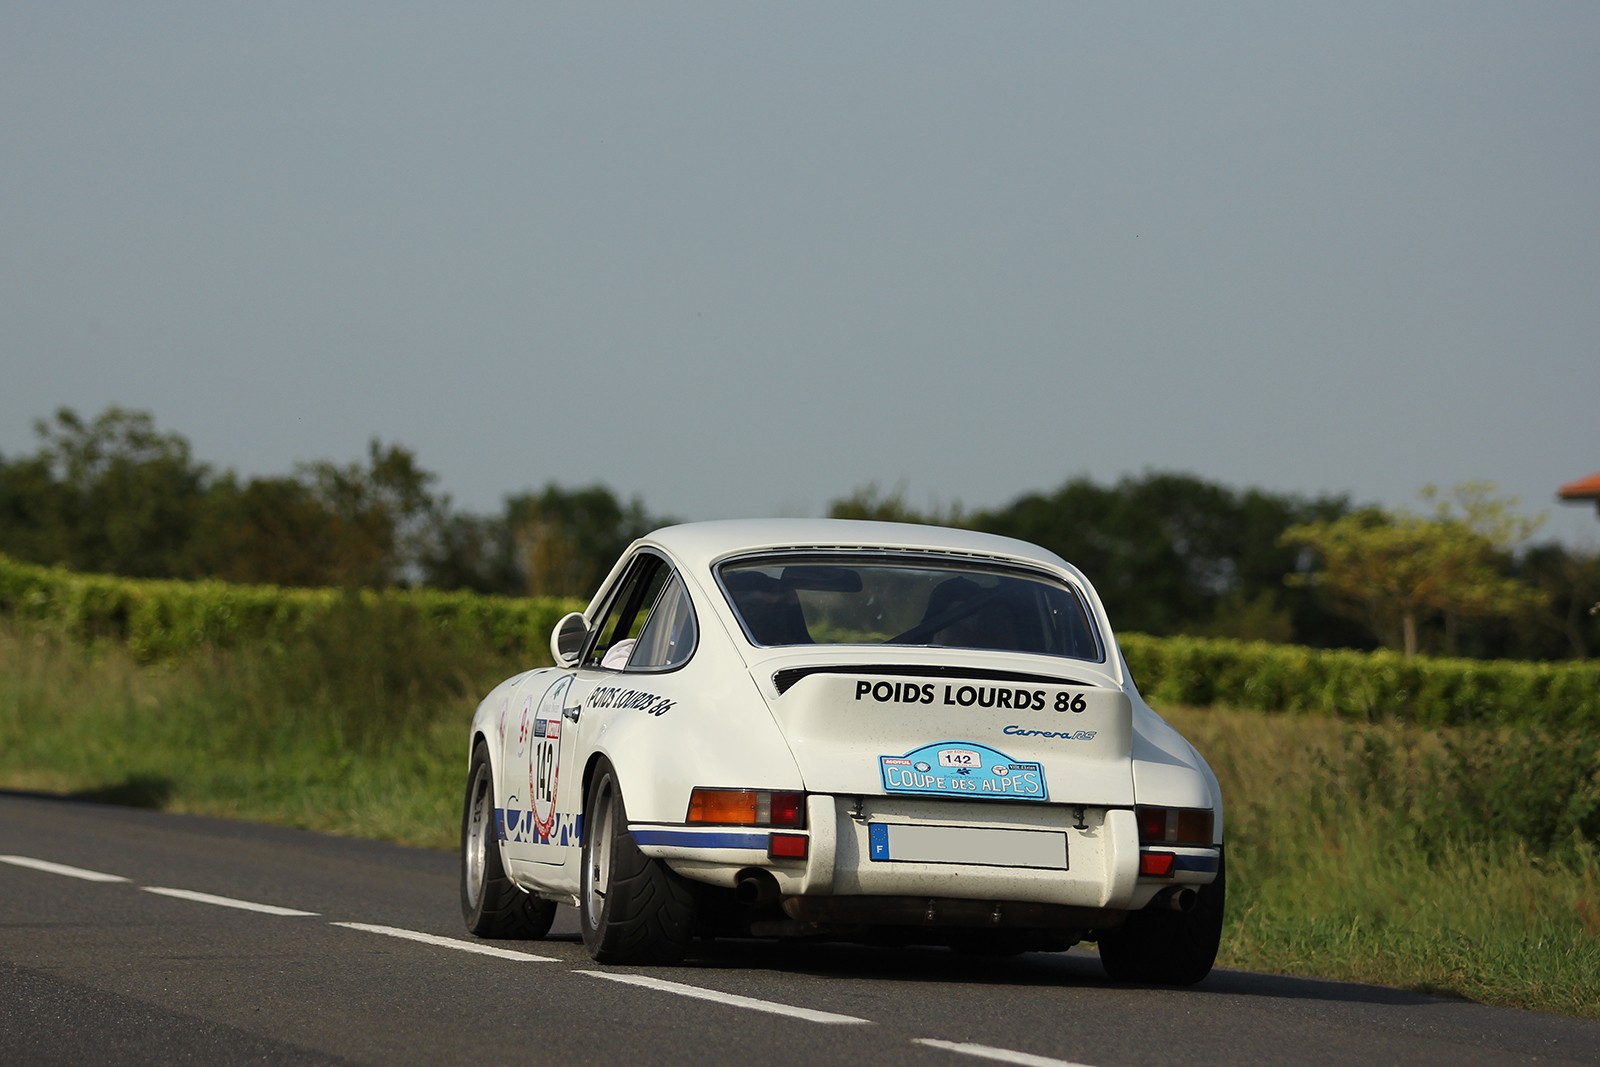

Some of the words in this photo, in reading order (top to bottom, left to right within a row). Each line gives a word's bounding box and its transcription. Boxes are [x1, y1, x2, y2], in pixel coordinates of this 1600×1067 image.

[587, 687, 621, 708] POIDS
[612, 689, 661, 710] LOURDS
[648, 699, 677, 717] 86
[855, 681, 935, 704] POIDS
[944, 685, 1046, 711] LOURDS
[1053, 691, 1087, 713] 86
[1003, 725, 1072, 740] Carrera
[1071, 730, 1097, 741] RS
[536, 741, 553, 802] 142
[945, 754, 972, 765] 142
[887, 767, 947, 789] COUPE
[951, 779, 977, 791] DES
[982, 772, 1039, 793] ALPES
[876, 845, 884, 853] F
